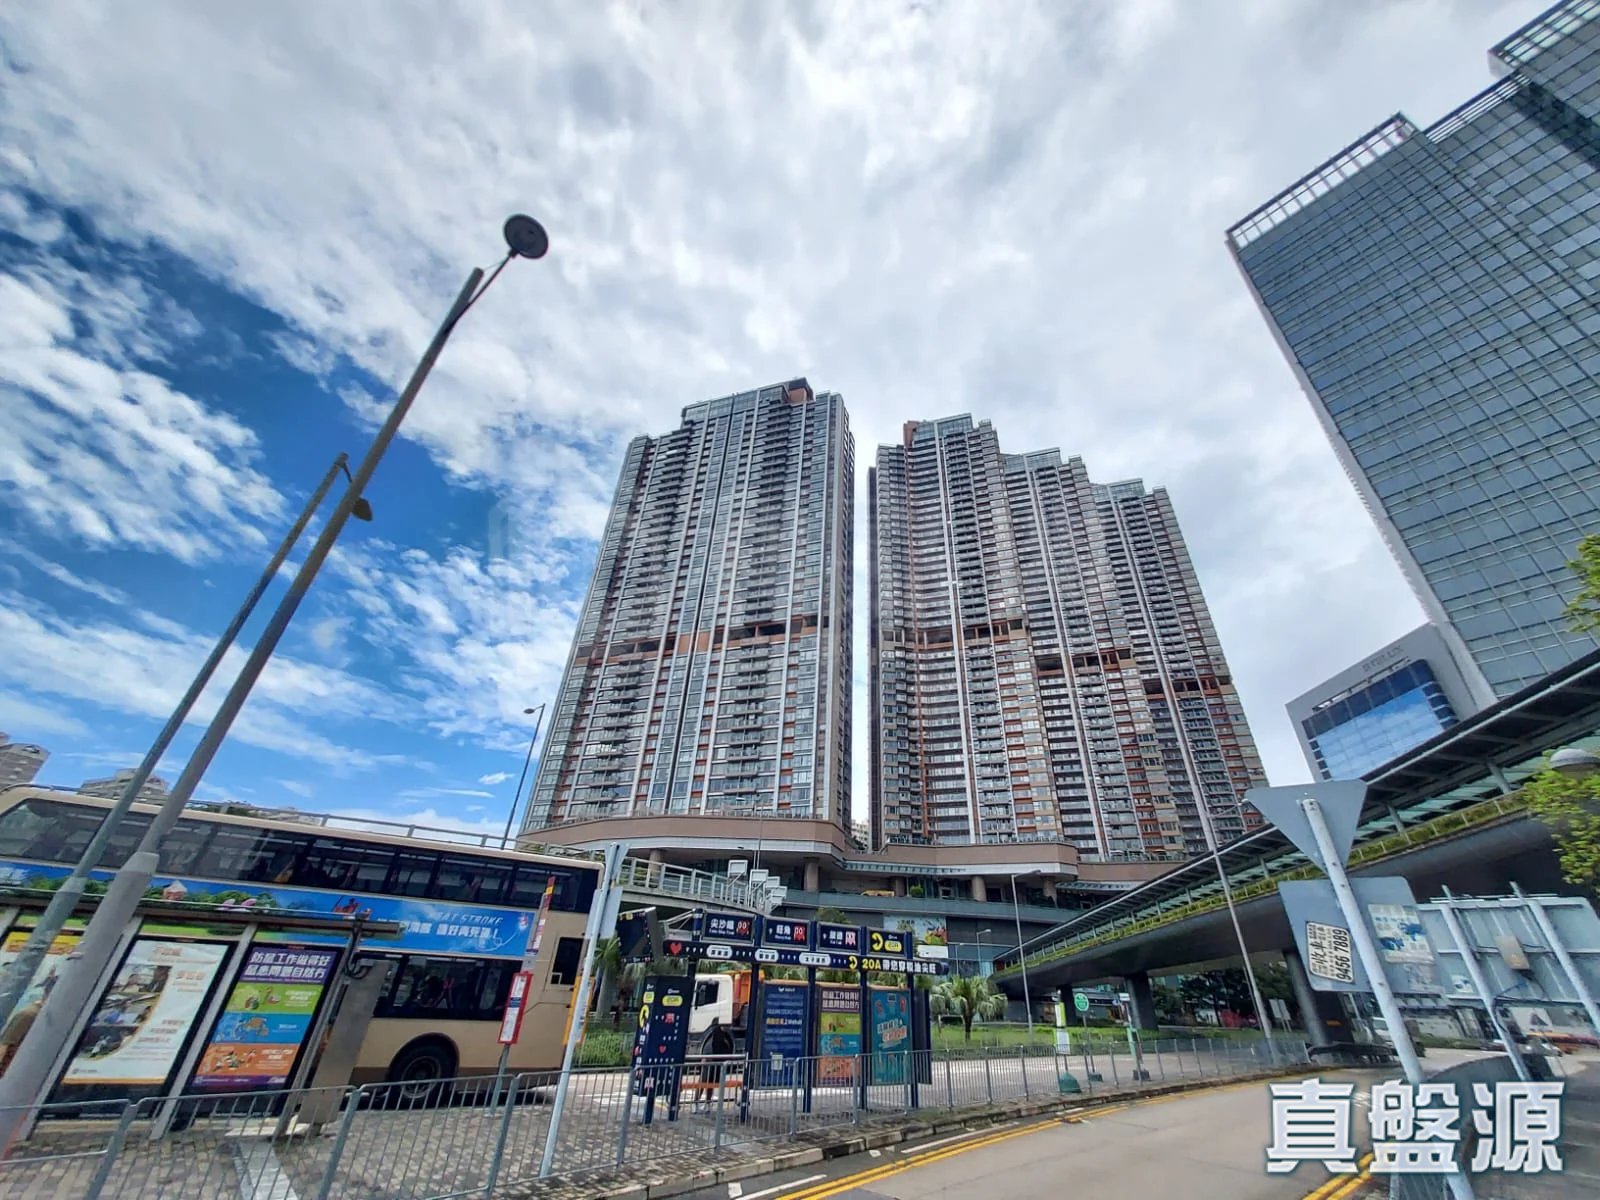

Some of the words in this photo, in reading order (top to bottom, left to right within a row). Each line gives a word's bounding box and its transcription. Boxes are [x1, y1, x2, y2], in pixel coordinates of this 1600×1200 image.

[1333, 929, 1349, 953] 7889
[862, 958, 881, 970] 20A
[1336, 956, 1352, 980] 9456
